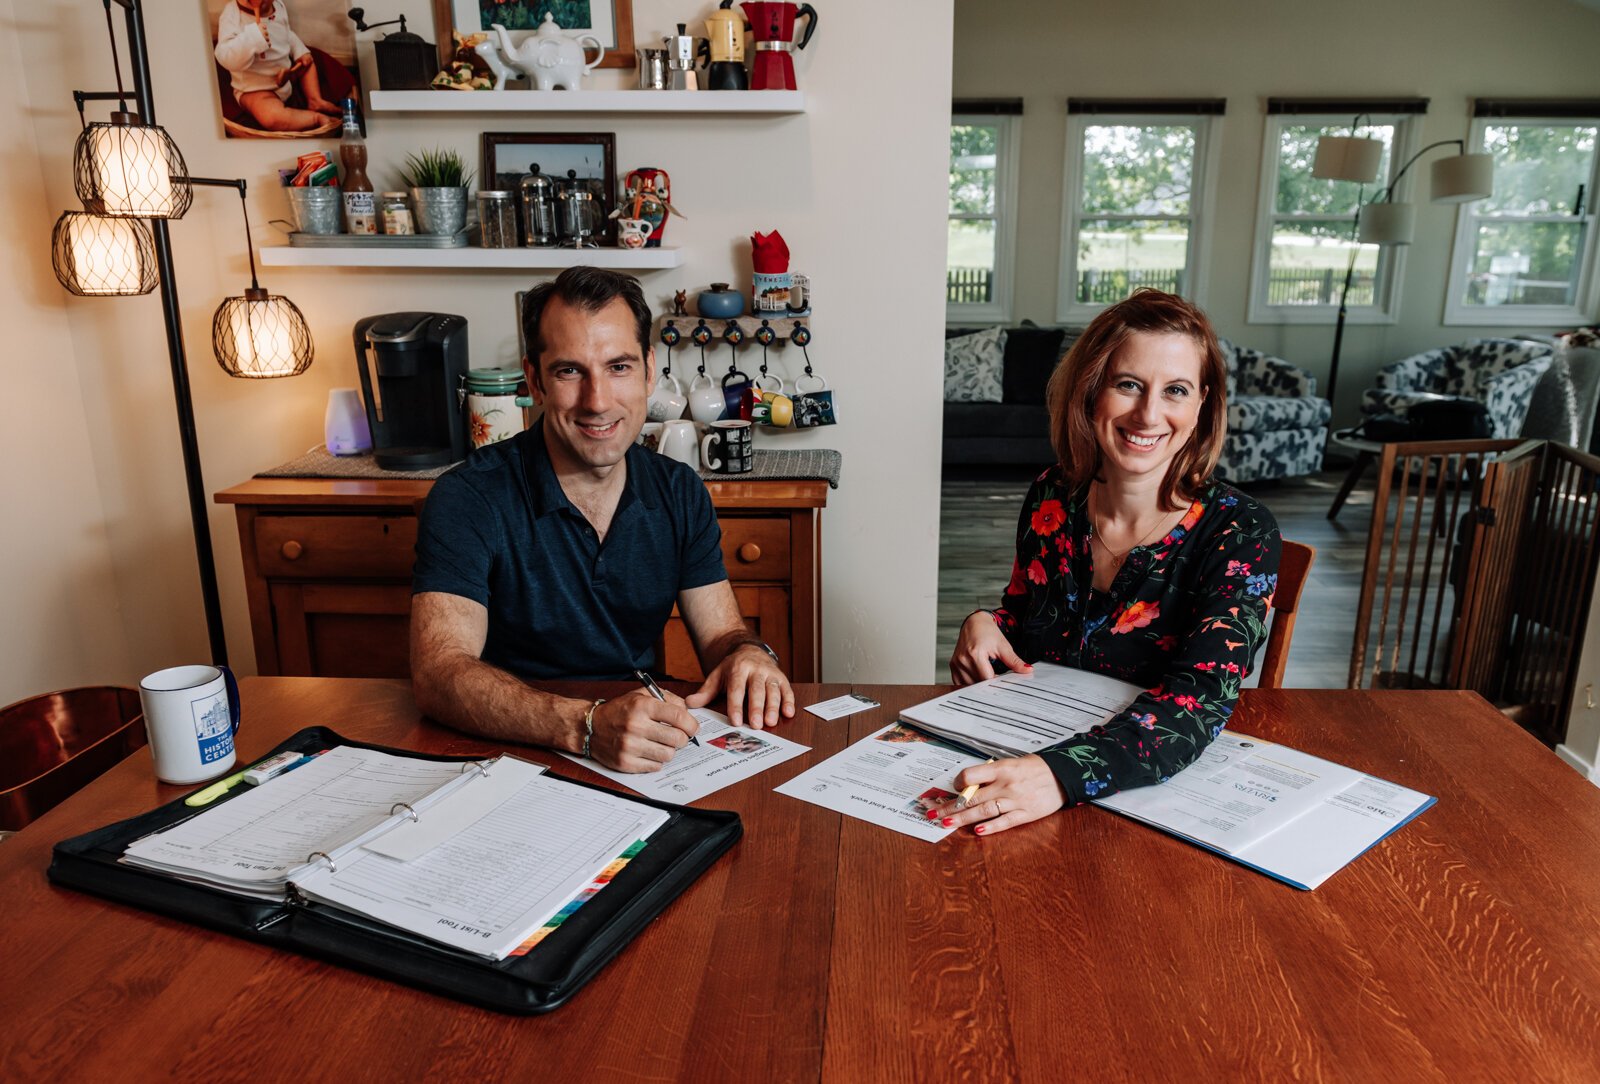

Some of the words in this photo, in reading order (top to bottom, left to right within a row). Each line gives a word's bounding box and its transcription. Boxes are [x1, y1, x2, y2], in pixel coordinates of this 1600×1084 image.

[217, 733, 228, 742] THE
[205, 743, 234, 761] CENTE
[850, 795, 868, 803] work
[868, 801, 886, 809] kind
[1366, 805, 1397, 819] Ohio
[899, 811, 939, 826] Strategies
[437, 918, 460, 929] Tool
[460, 925, 492, 939] B-List
